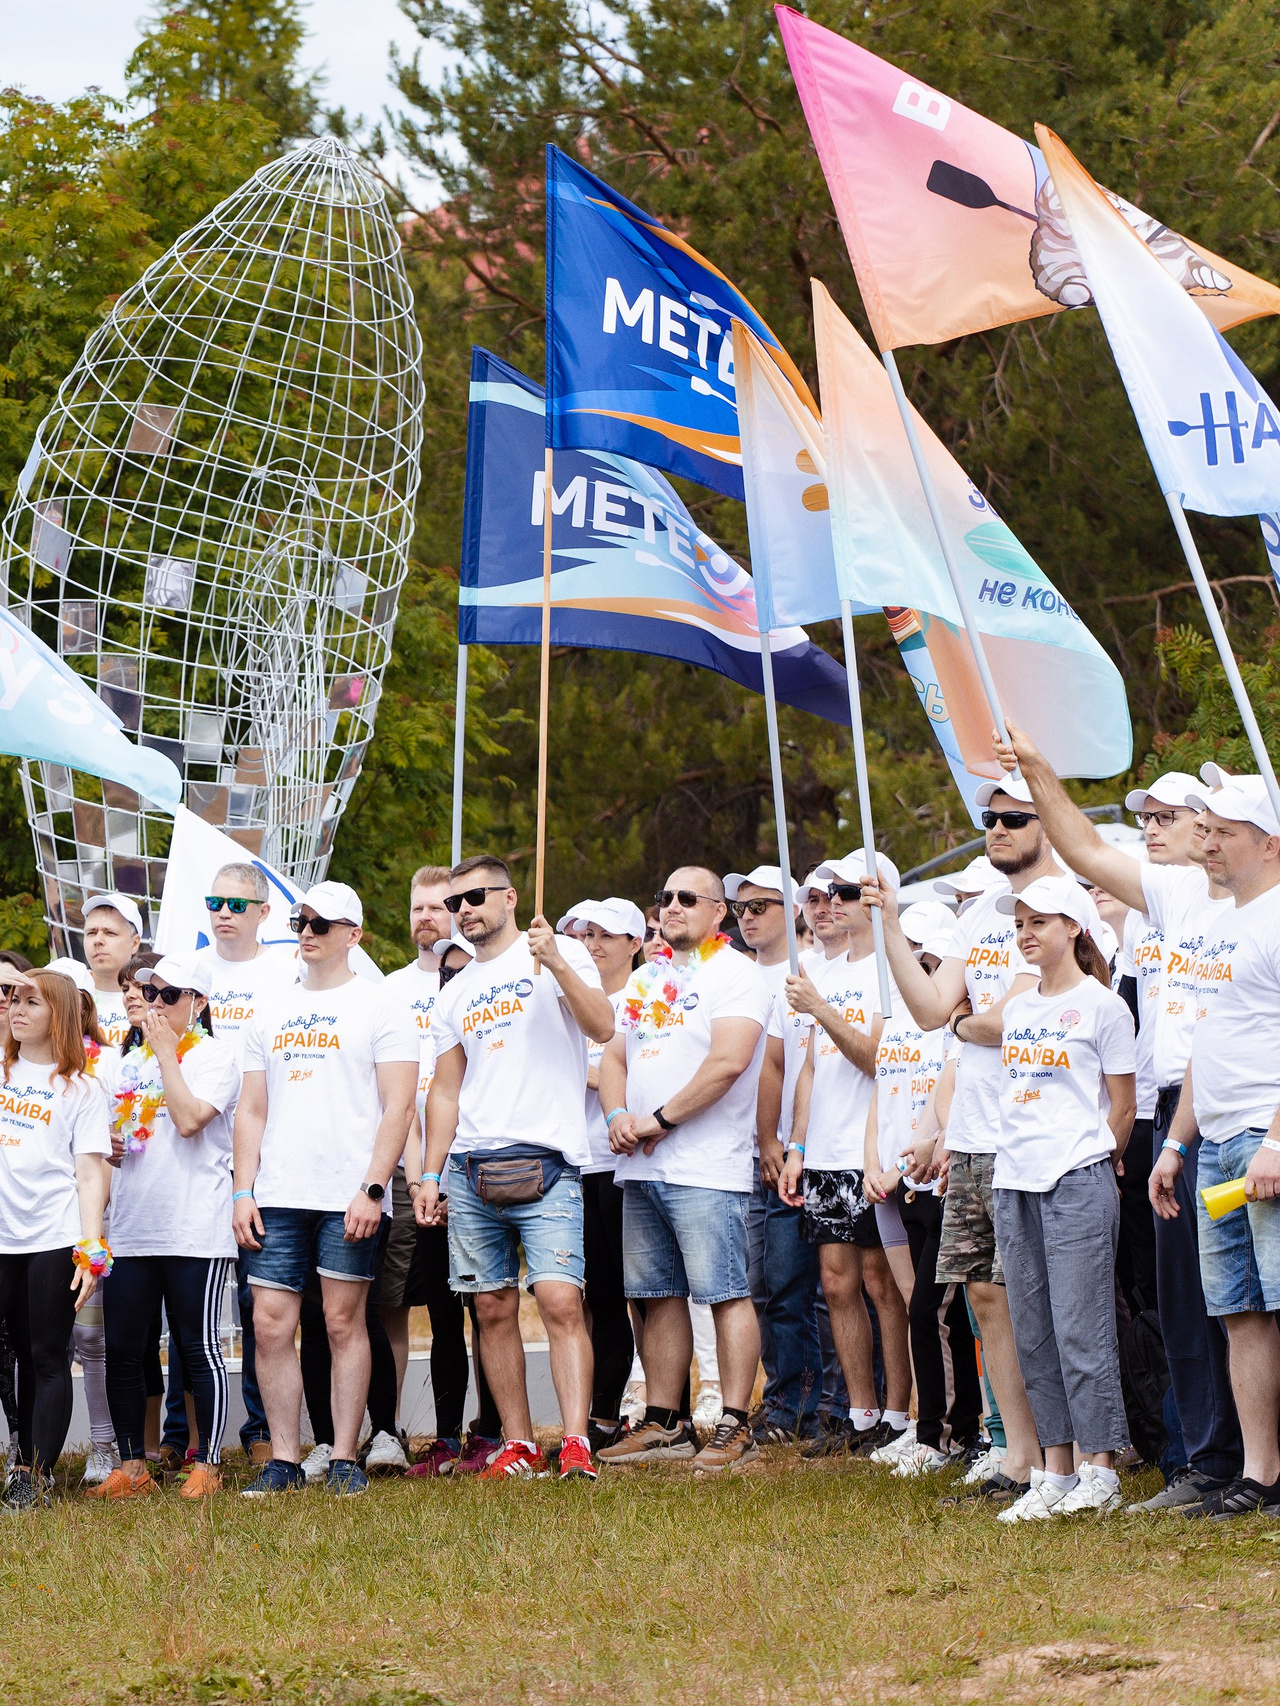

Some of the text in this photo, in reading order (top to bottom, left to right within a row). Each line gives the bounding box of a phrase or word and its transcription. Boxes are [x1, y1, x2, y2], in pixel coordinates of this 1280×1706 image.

[210, 1004, 254, 1020] АЙВА
[272, 1029, 341, 1053] ДРАЙВА
[1007, 1028, 1036, 1042] Лови
